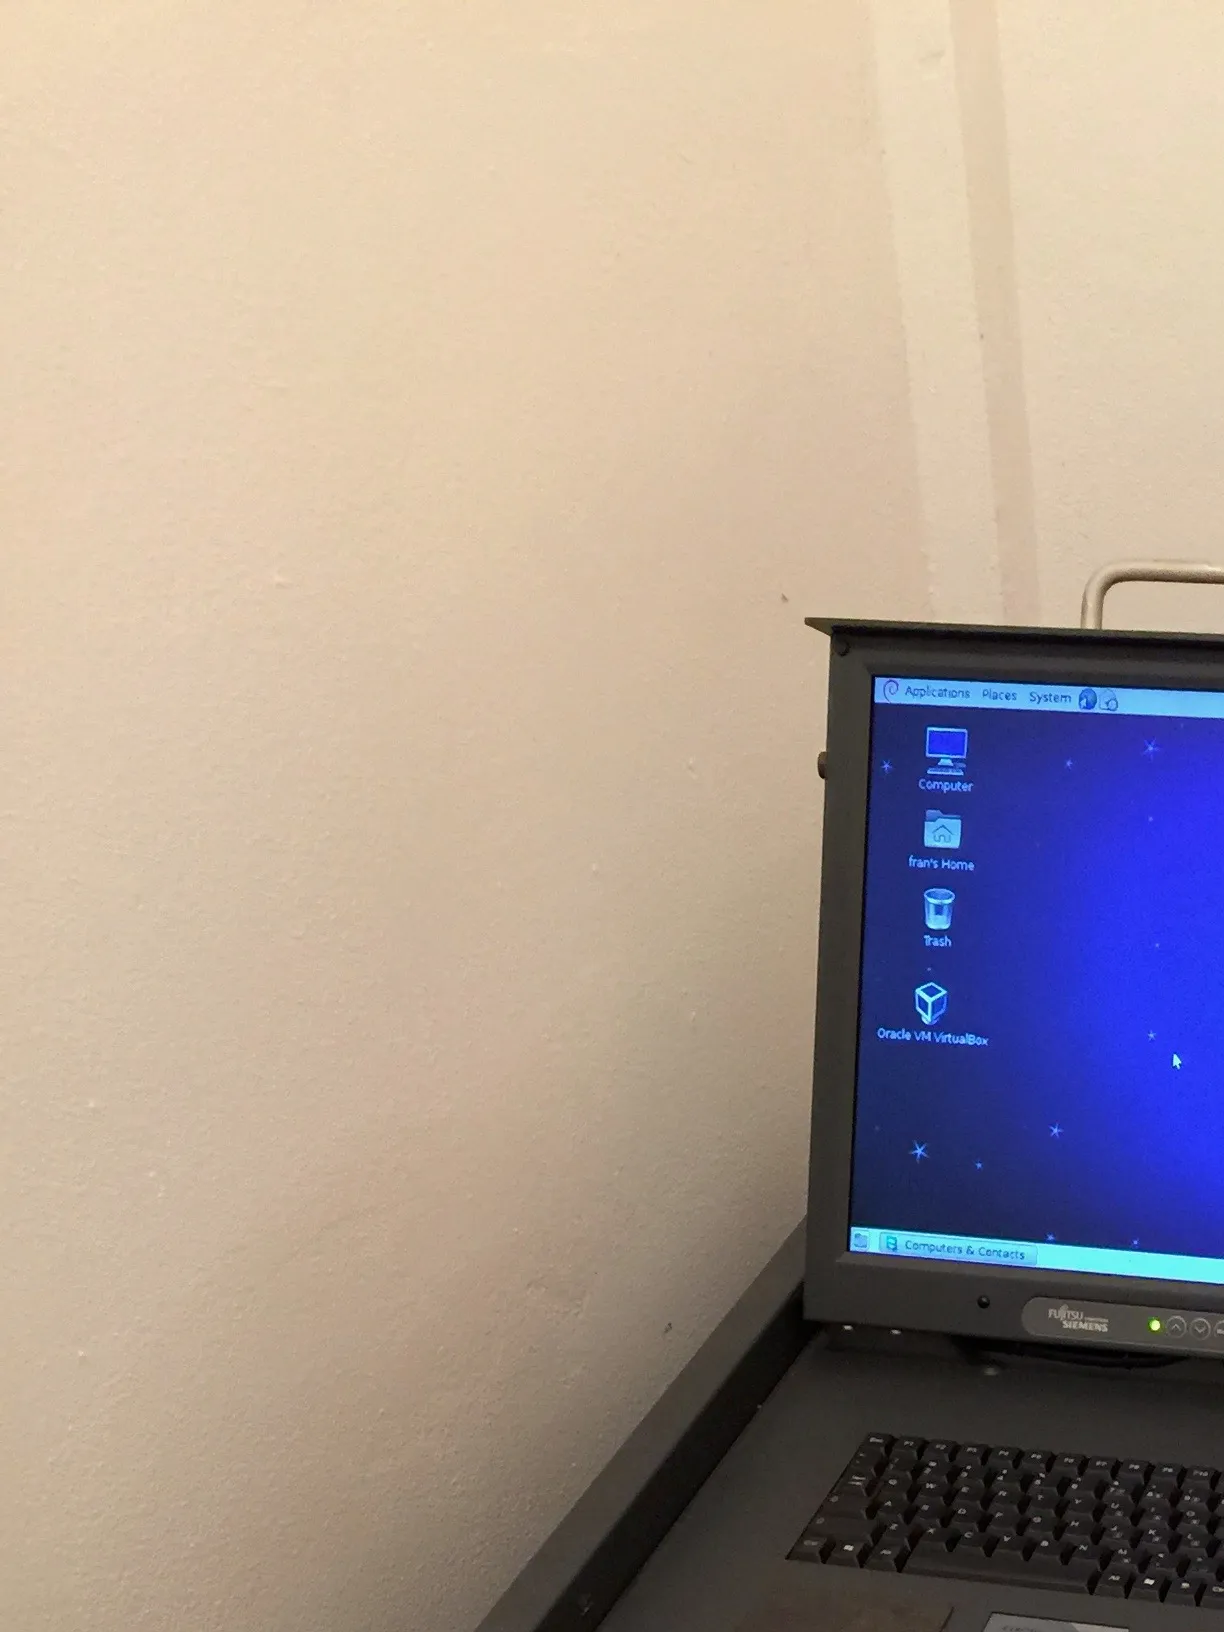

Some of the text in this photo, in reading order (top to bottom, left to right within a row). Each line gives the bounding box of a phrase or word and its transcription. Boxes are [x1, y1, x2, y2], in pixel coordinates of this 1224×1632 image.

[904, 685, 1072, 706] Applications Places System
[918, 778, 974, 795] Computer
[908, 855, 975, 871] fran's Home
[923, 934, 952, 947] Trash
[877, 1027, 989, 1046] Oracle VM VirtualBox
[904, 1239, 1025, 1261] Computers & Contacts
[1047, 1305, 1084, 1321] FUJITSU
[1062, 1319, 1109, 1332] SIEMENS
